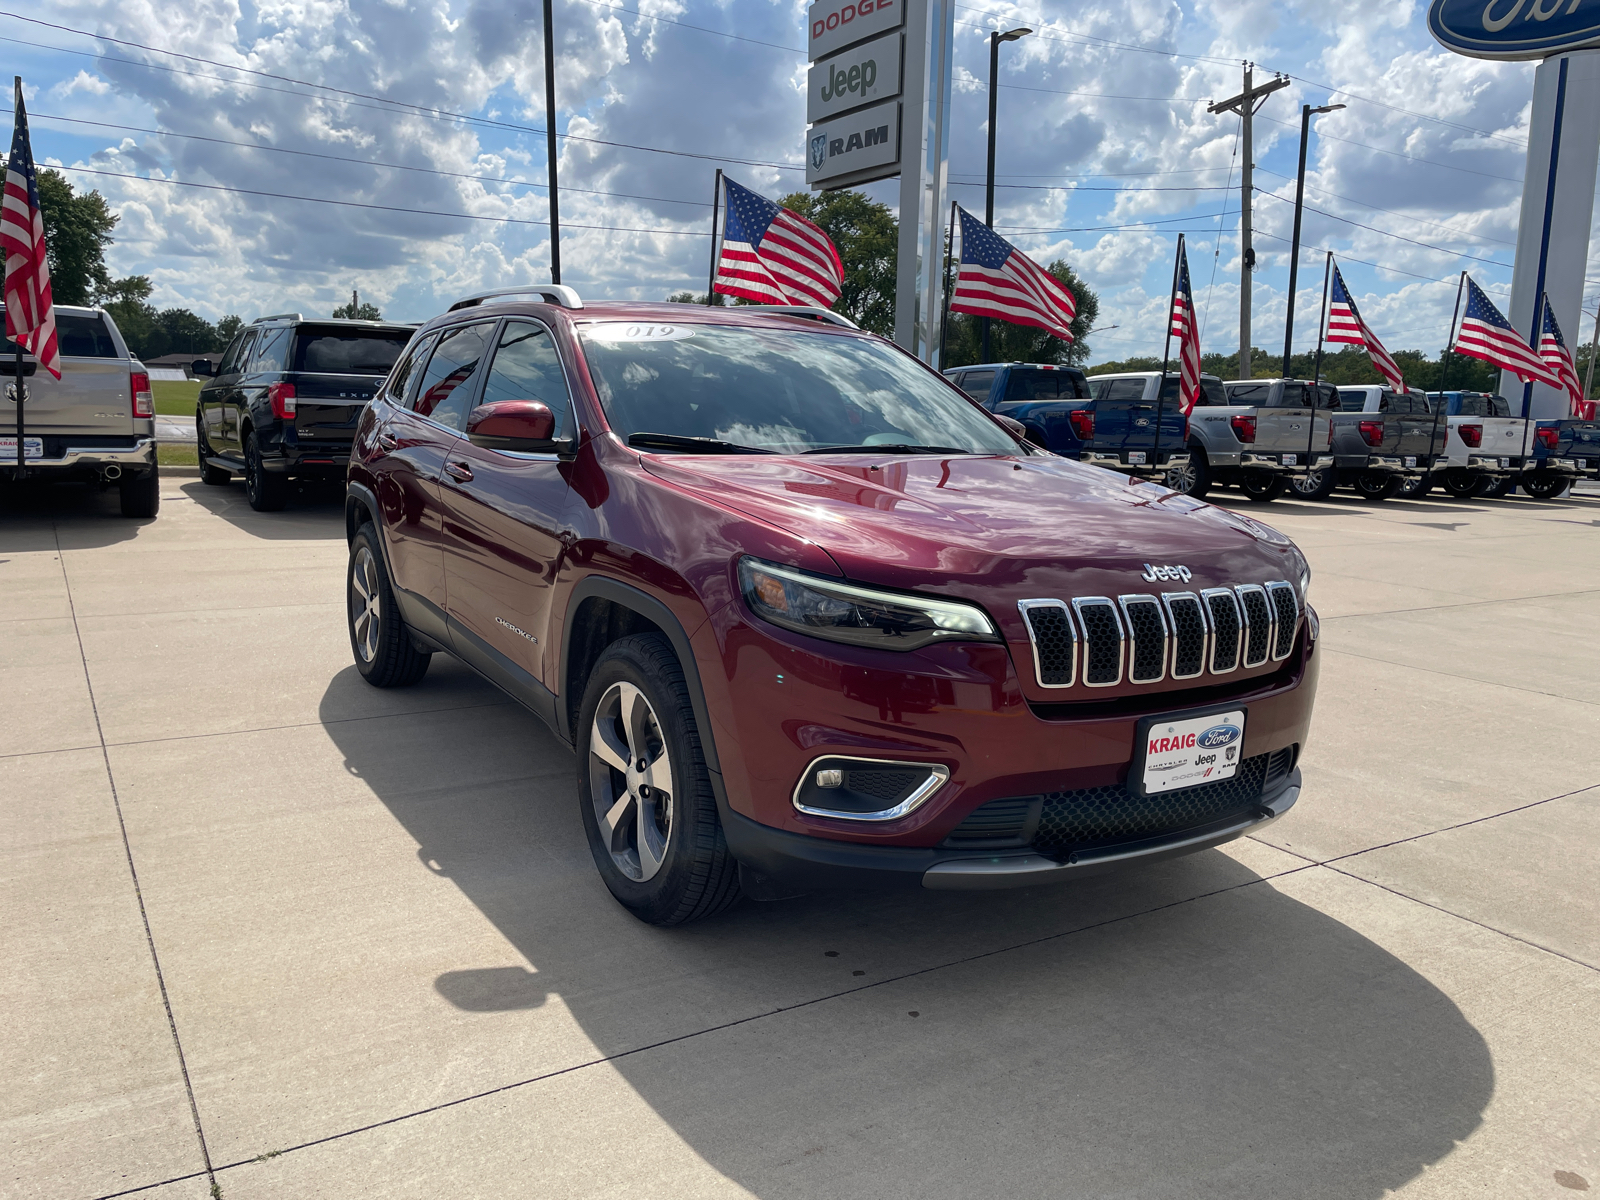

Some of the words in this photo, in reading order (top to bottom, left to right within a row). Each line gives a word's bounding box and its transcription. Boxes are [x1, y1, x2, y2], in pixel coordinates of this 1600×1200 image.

[813, 0, 893, 39] DODGE
[821, 59, 877, 102] Jeep
[829, 125, 888, 157] RAM
[625, 326, 676, 338] 019
[1141, 563, 1192, 584] Jeep
[495, 616, 538, 645] CHEROKEE
[1149, 733, 1196, 755] KRAIG
[1204, 728, 1232, 746] Ford
[1148, 759, 1188, 768] CHRYSLER
[1195, 754, 1216, 766] Jeep
